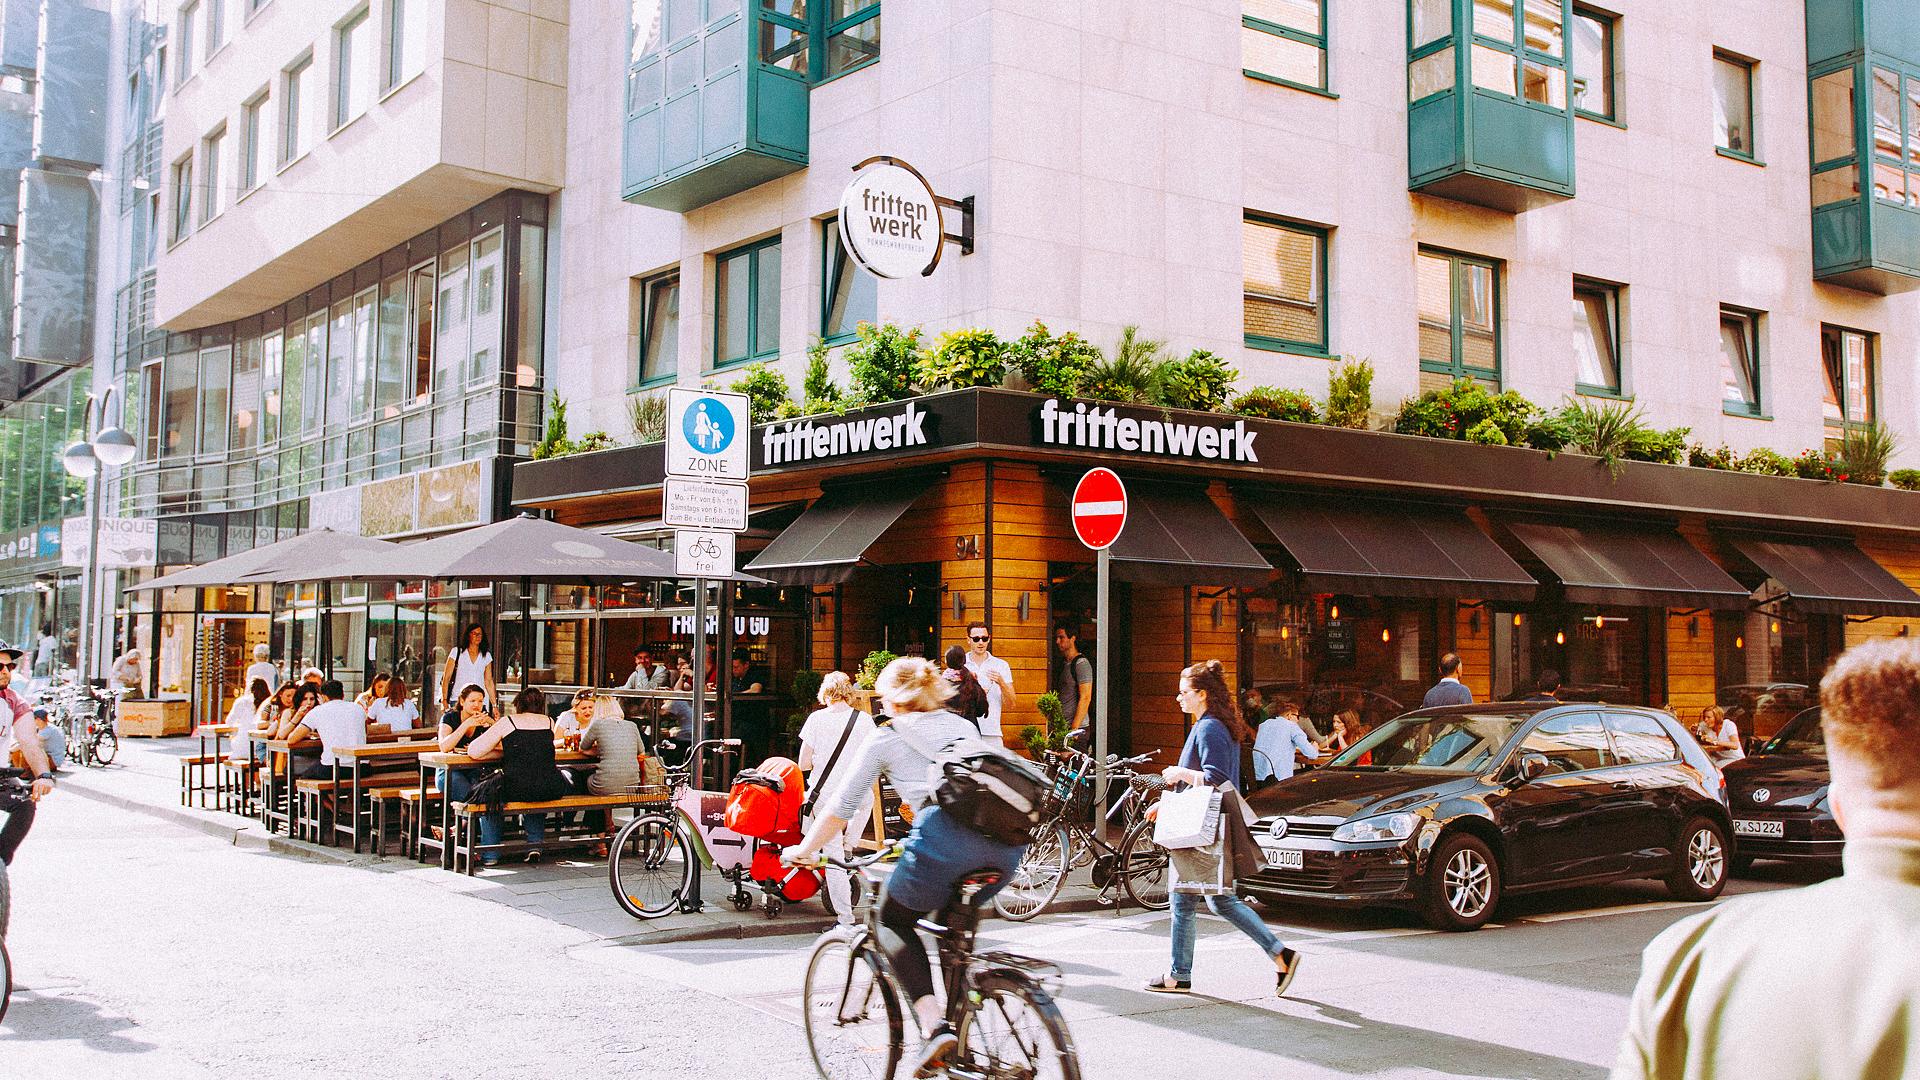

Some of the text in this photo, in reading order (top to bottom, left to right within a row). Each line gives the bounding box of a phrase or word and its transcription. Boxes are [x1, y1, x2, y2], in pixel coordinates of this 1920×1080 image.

[863, 188, 927, 221] fritten
[869, 215, 922, 240] werk
[763, 401, 927, 465] frittenwerk
[1040, 399, 1258, 462] frittenwerk
[688, 457, 728, 473] ZONE
[670, 503, 700, 513] Samstags
[99, 519, 155, 534] NIQUE
[704, 515, 731, 524] Entladen
[696, 561, 714, 571] frei
[1762, 822, 1782, 833] 224
[1279, 851, 1302, 866] 1000
